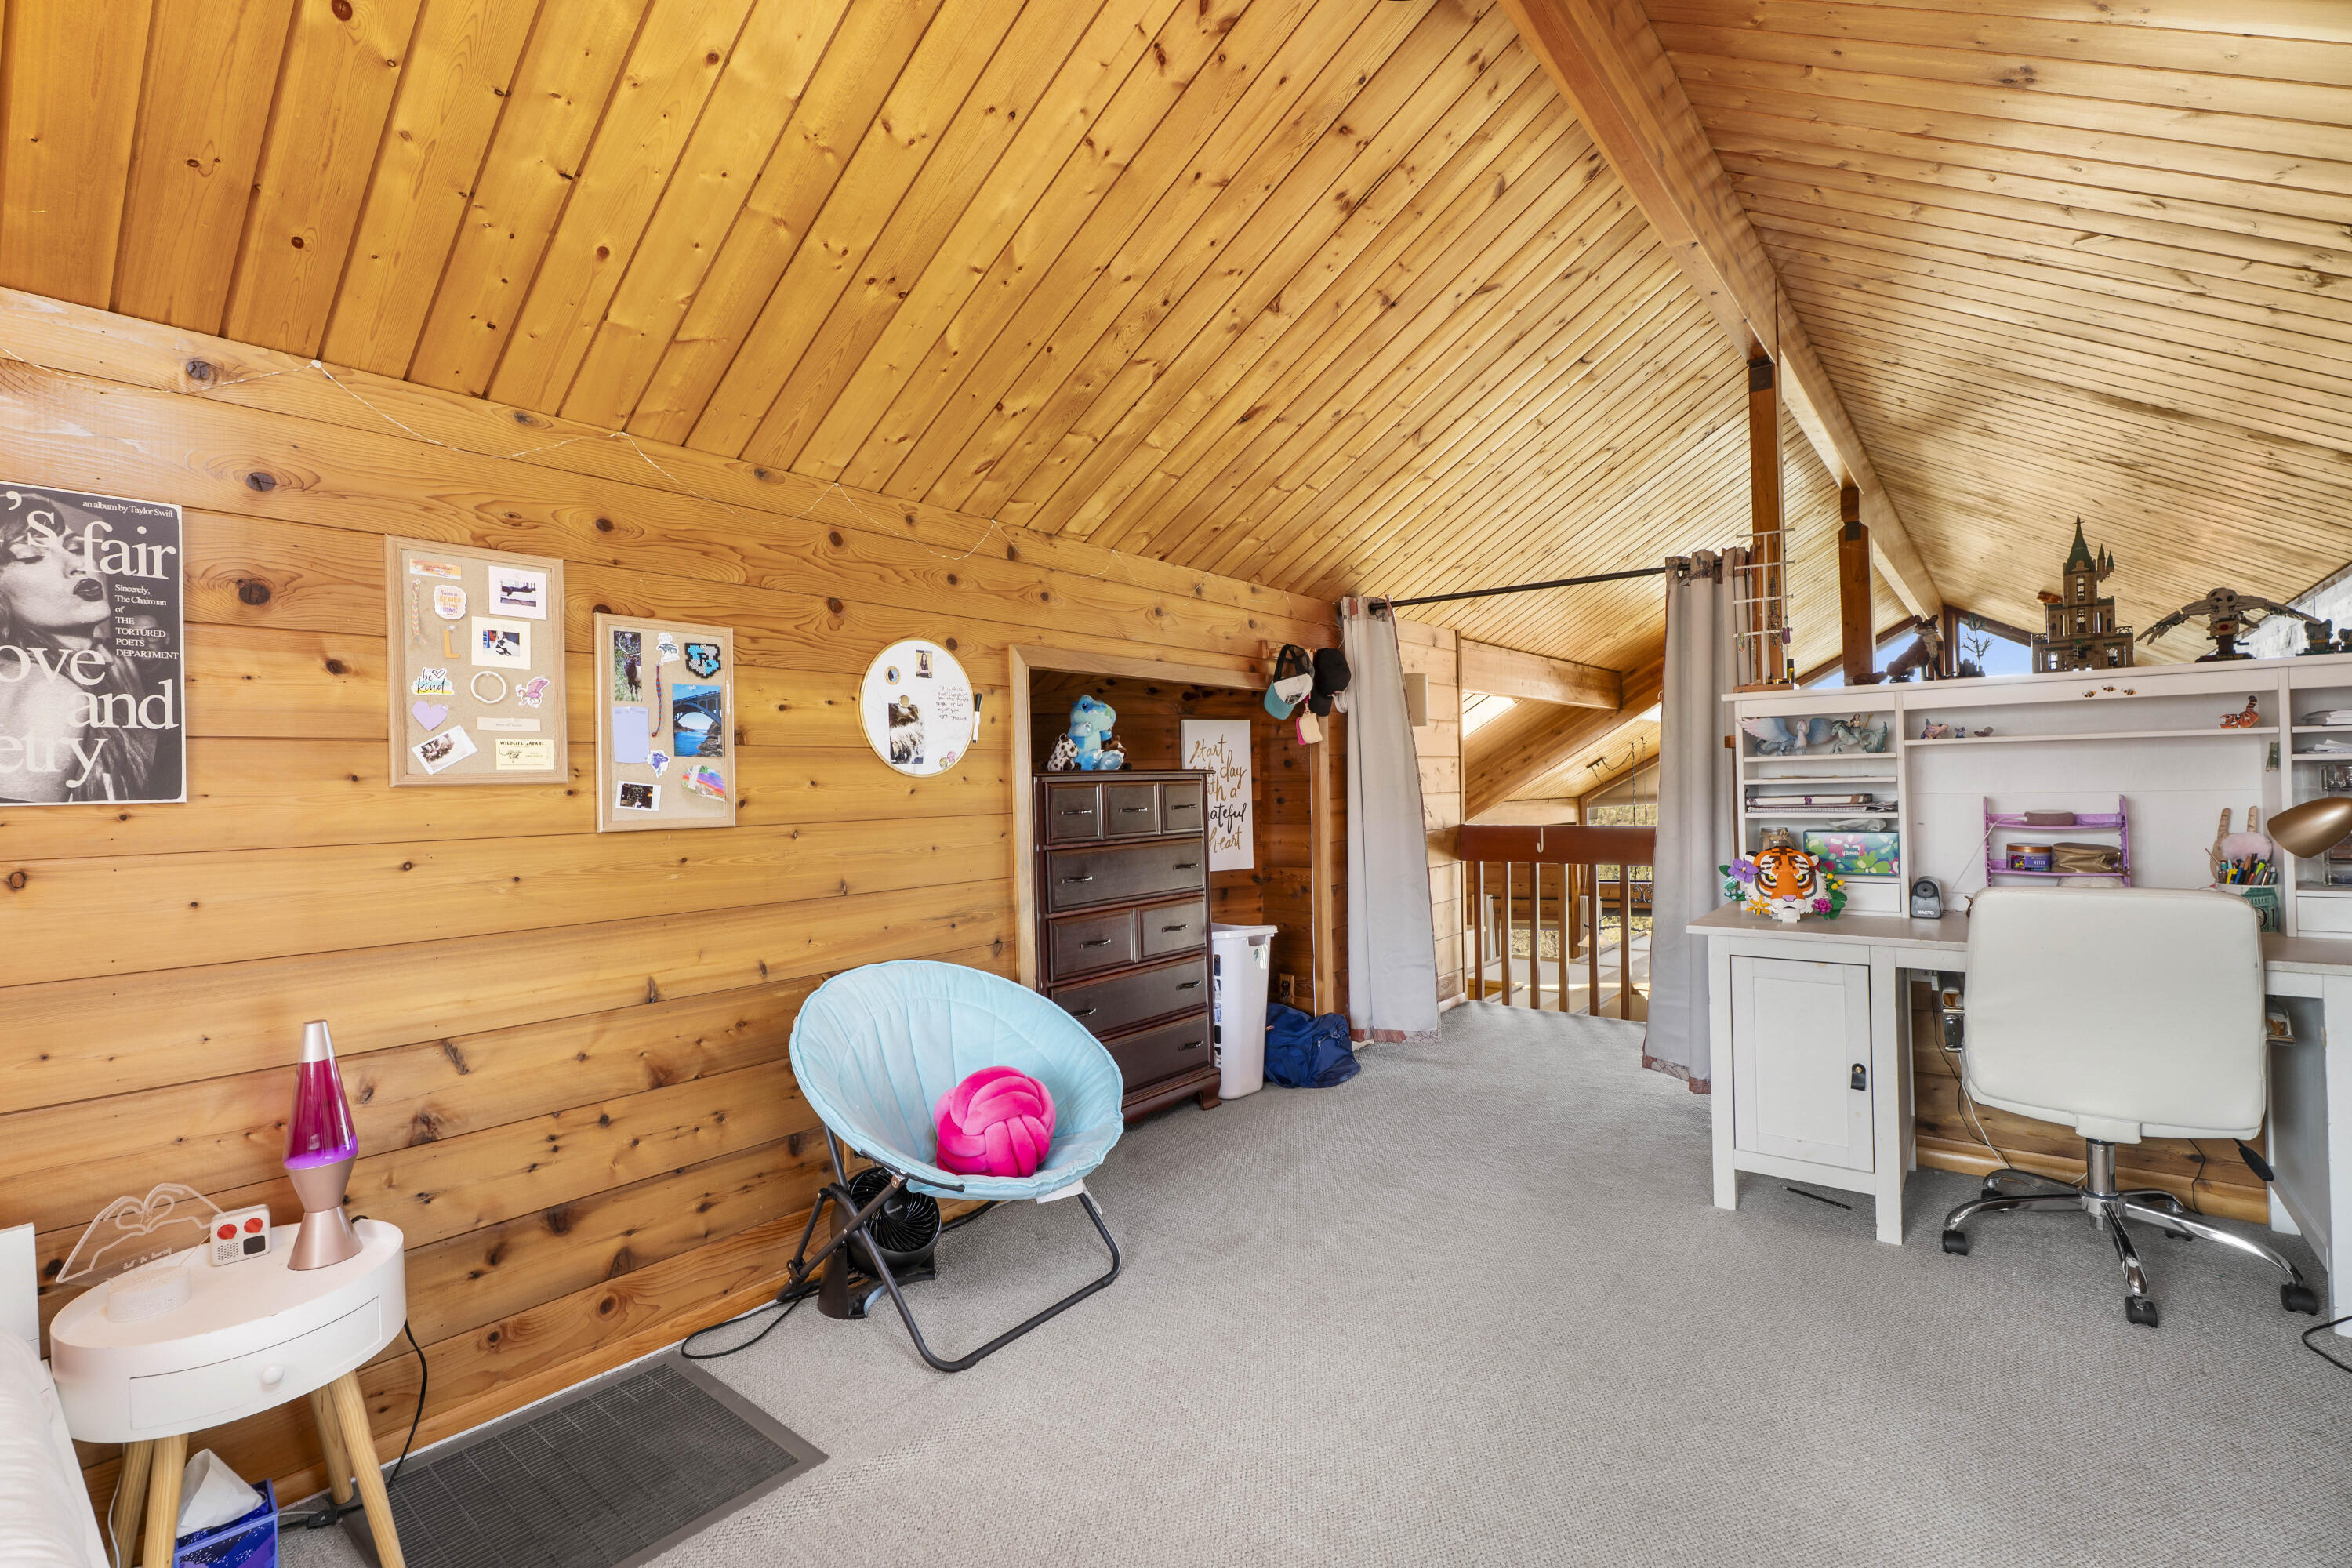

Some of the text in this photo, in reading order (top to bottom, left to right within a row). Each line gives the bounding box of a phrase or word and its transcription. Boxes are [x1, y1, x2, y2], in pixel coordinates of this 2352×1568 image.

[93, 501, 118, 512] album
[118, 504, 129, 514] by
[129, 505, 153, 515] Taylor
[154, 508, 174, 517] Swift
[0, 491, 177, 579] 's fair
[114, 584, 151, 595] Sincerely,
[114, 594, 167, 606] The Chairman
[114, 616, 135, 625] THE
[115, 627, 166, 637] TORTURED
[115, 638, 145, 647] POETS
[116, 649, 180, 659] DEPARTMENT
[423, 668, 433, 681] be
[417, 677, 445, 694] kind
[68, 678, 180, 730] and
[1220, 750, 1247, 789] day
[1207, 775, 1239, 802] ith a
[1208, 802, 1247, 834] ateful
[1208, 826, 1243, 854] heart
